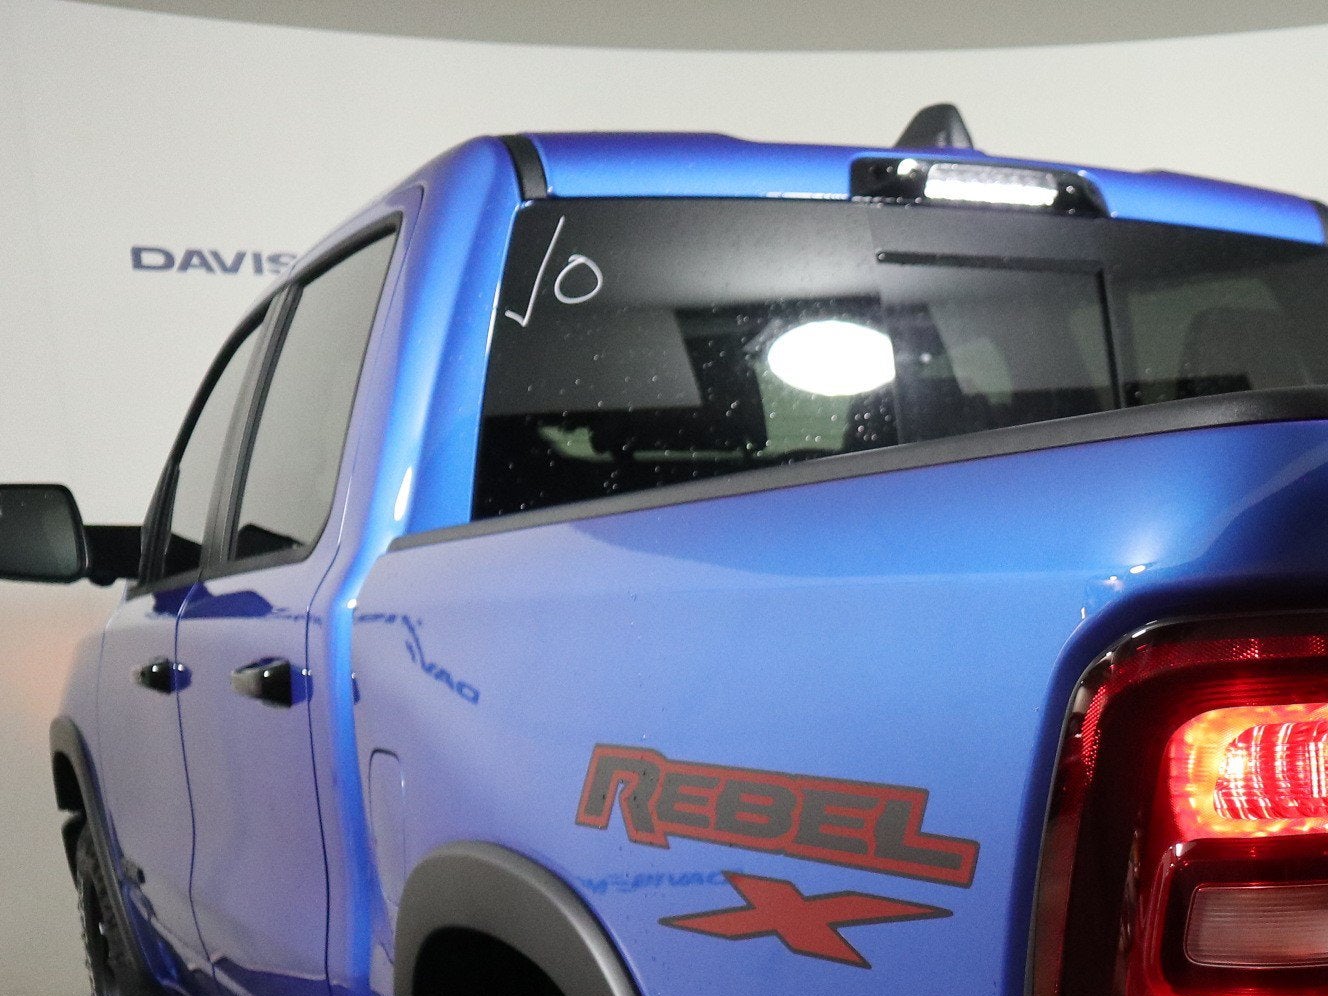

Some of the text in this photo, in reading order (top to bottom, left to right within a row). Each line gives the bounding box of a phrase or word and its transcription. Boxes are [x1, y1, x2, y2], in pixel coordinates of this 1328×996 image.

[130, 245, 298, 275] DAVIS
[576, 743, 980, 888] REBEL
[657, 869, 954, 970] X
